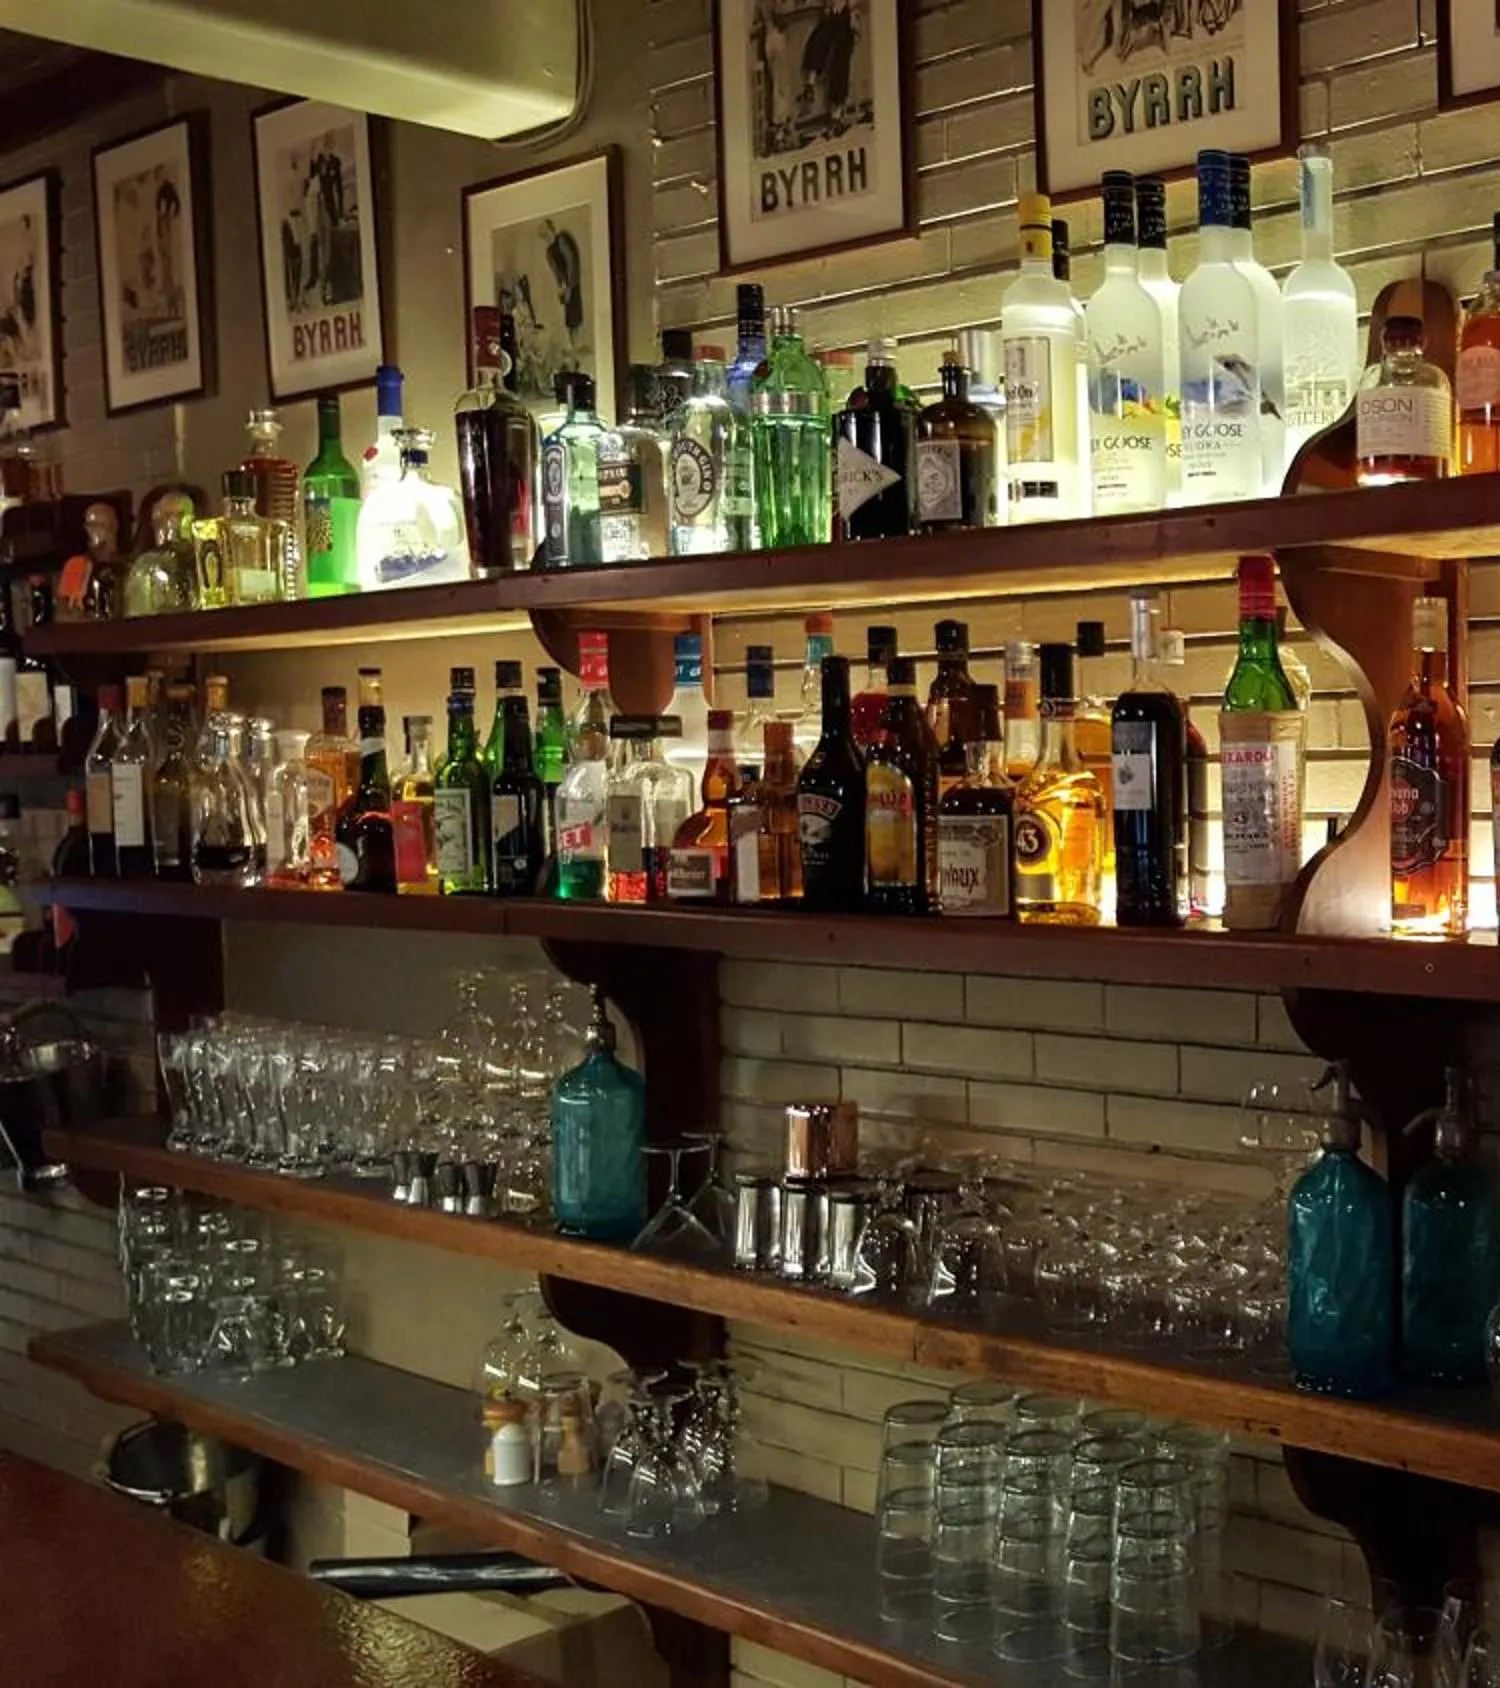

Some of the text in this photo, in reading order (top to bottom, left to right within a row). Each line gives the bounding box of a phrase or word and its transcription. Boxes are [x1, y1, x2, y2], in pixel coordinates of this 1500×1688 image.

[1088, 56, 1236, 141] BYRRH
[762, 147, 867, 214] BYRRH
[293, 311, 365, 359] BYRRH
[1016, 828, 1039, 853] 43
